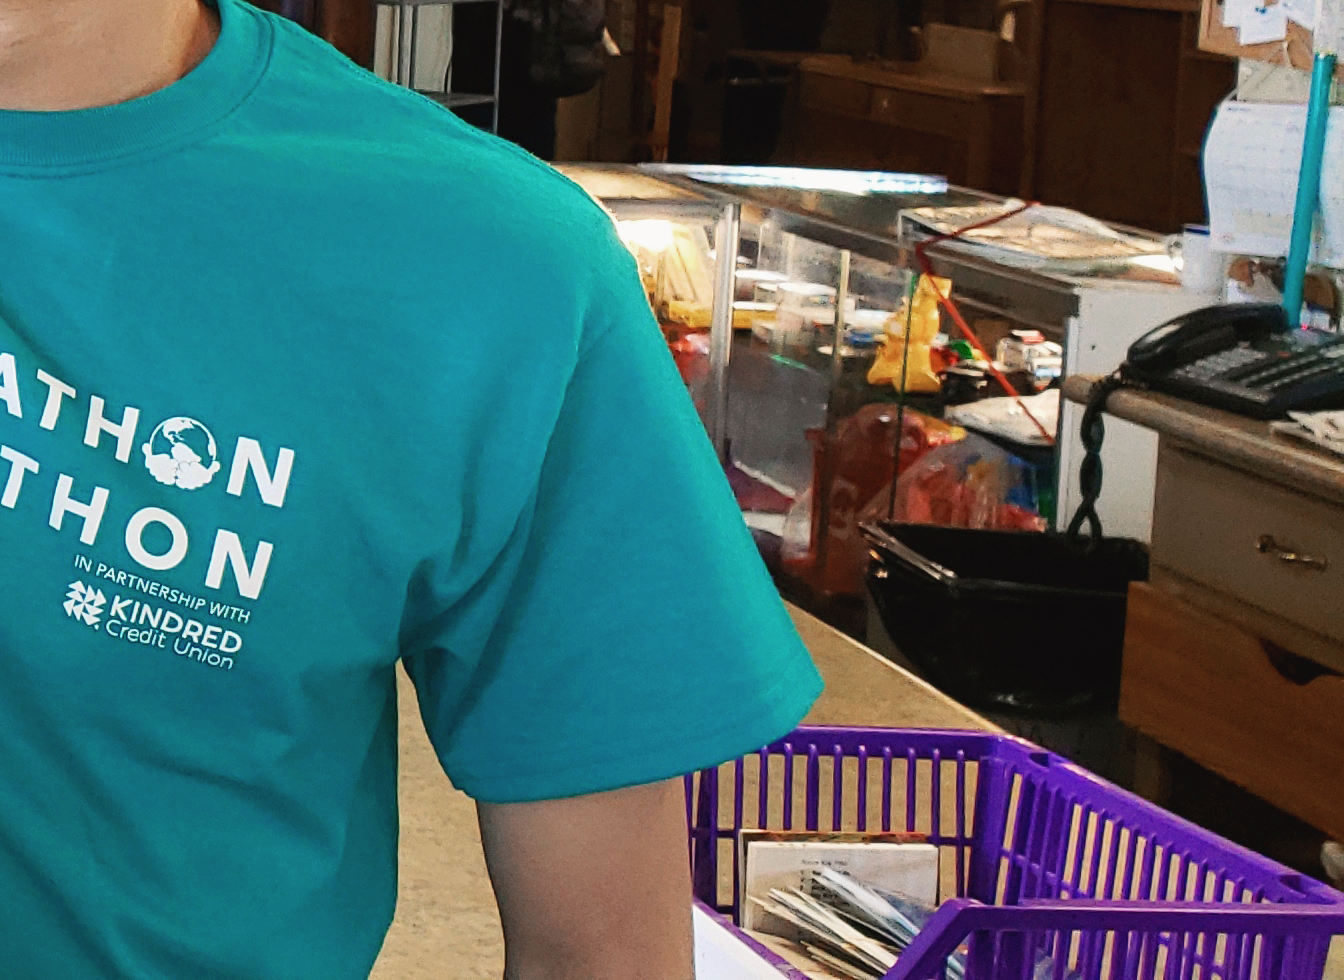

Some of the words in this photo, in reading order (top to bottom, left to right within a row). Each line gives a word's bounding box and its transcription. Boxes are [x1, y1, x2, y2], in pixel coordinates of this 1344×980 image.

[74, 554, 93, 573] IN
[95, 562, 206, 611] PARTNERSHIP
[209, 601, 251, 624] WITH
[105, 619, 167, 649] Credit
[173, 637, 234, 670] Union
[110, 594, 243, 653] KINDRED
